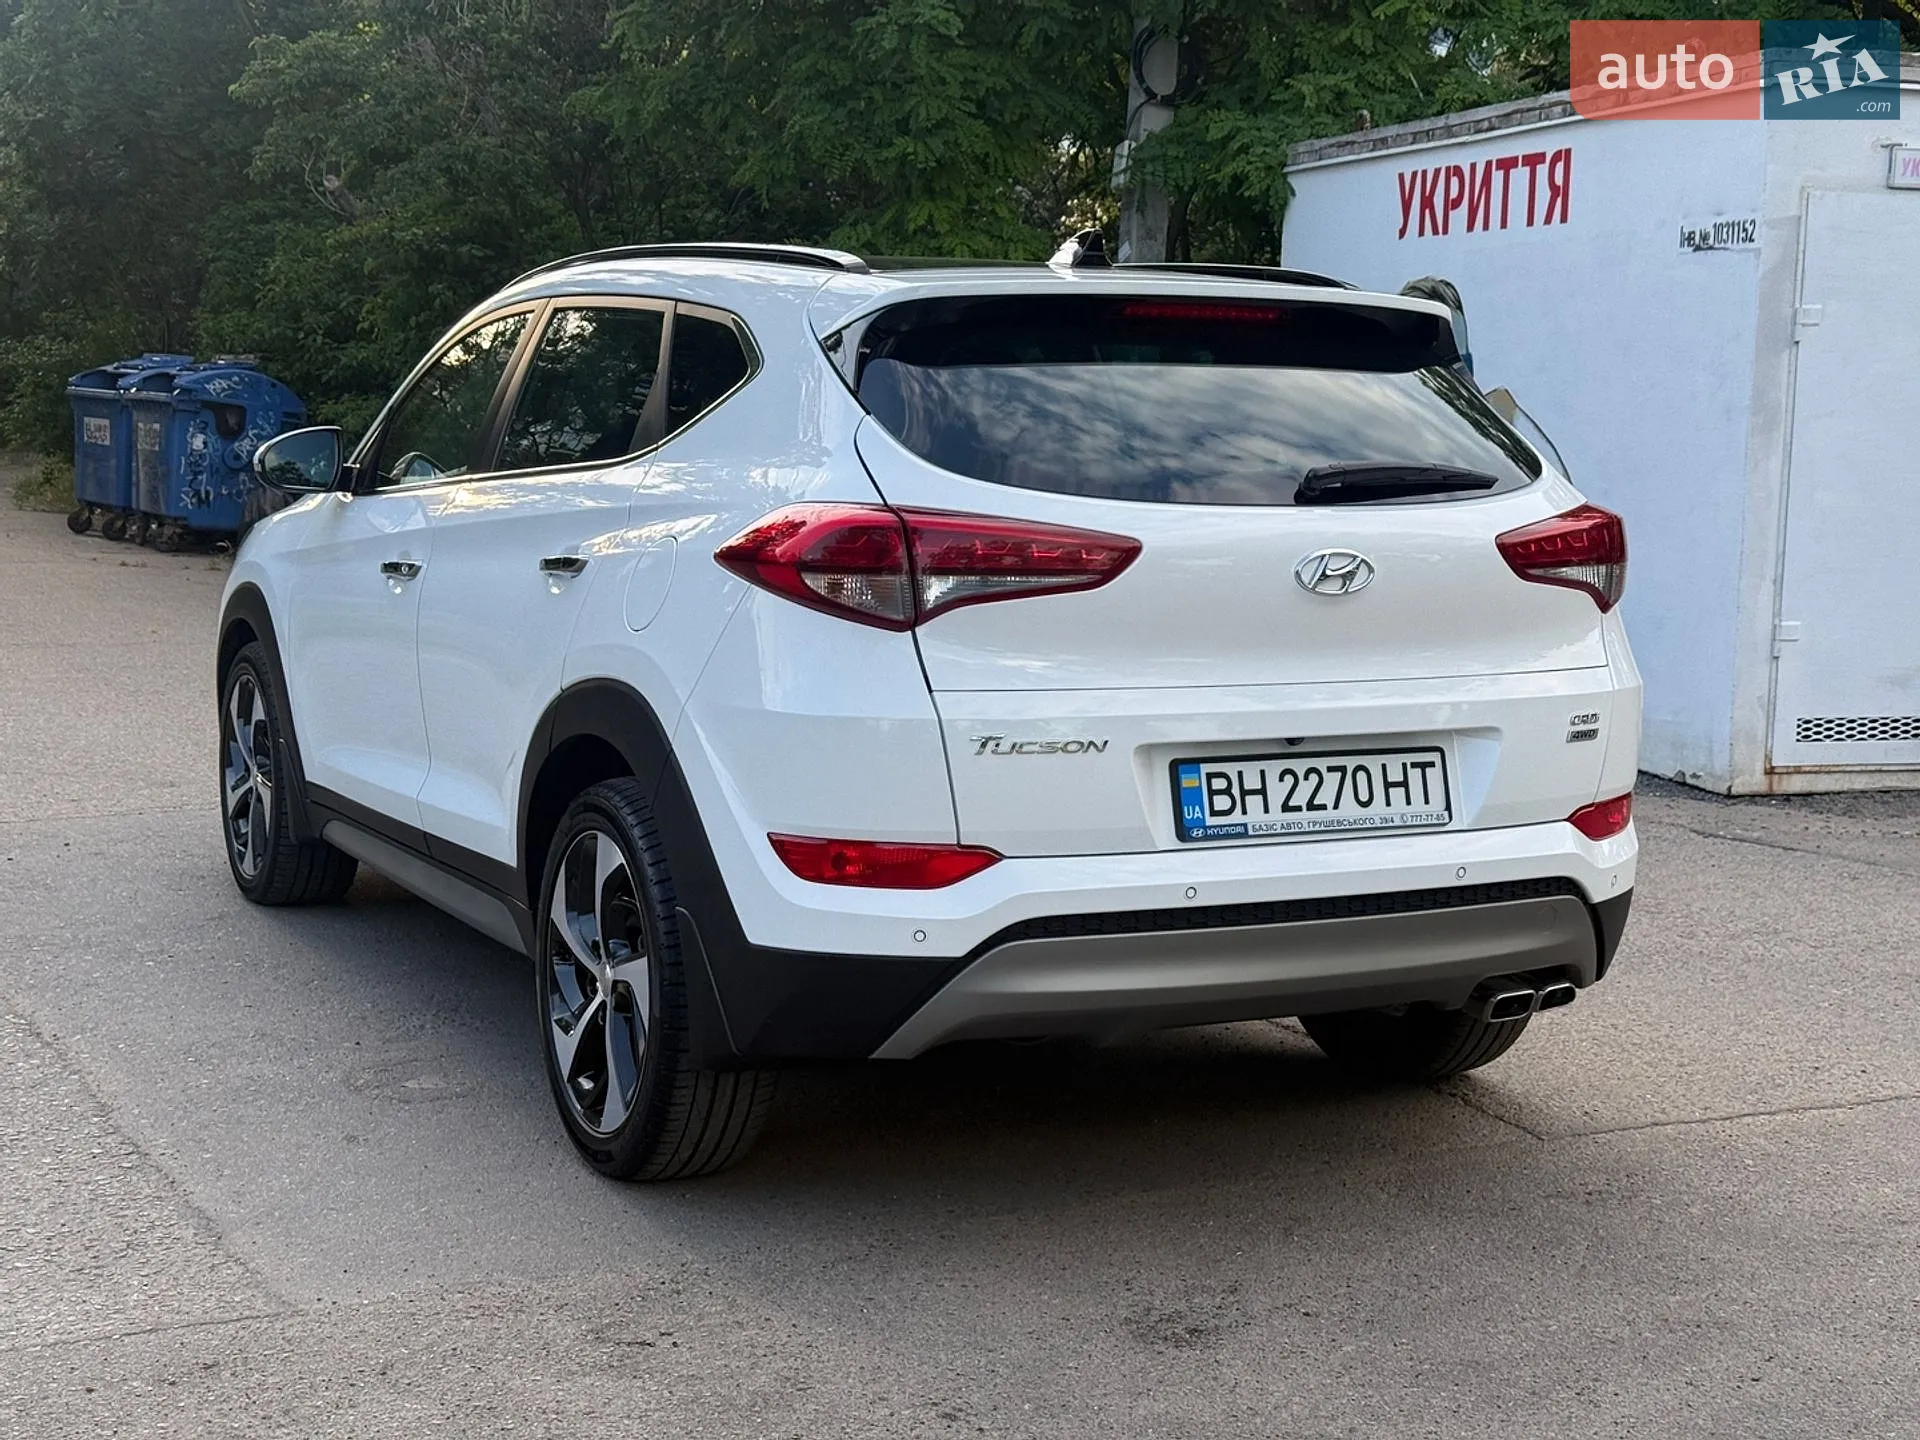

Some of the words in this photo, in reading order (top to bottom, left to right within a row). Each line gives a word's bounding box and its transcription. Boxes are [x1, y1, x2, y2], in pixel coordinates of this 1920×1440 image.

[1398, 147, 1573, 240] УКРИТТЯ
[1712, 218, 1756, 245] 1031152
[1278, 764, 1374, 814] 2270
[1184, 806, 1203, 820] UA
[1206, 826, 1246, 836] HYUNDAI
